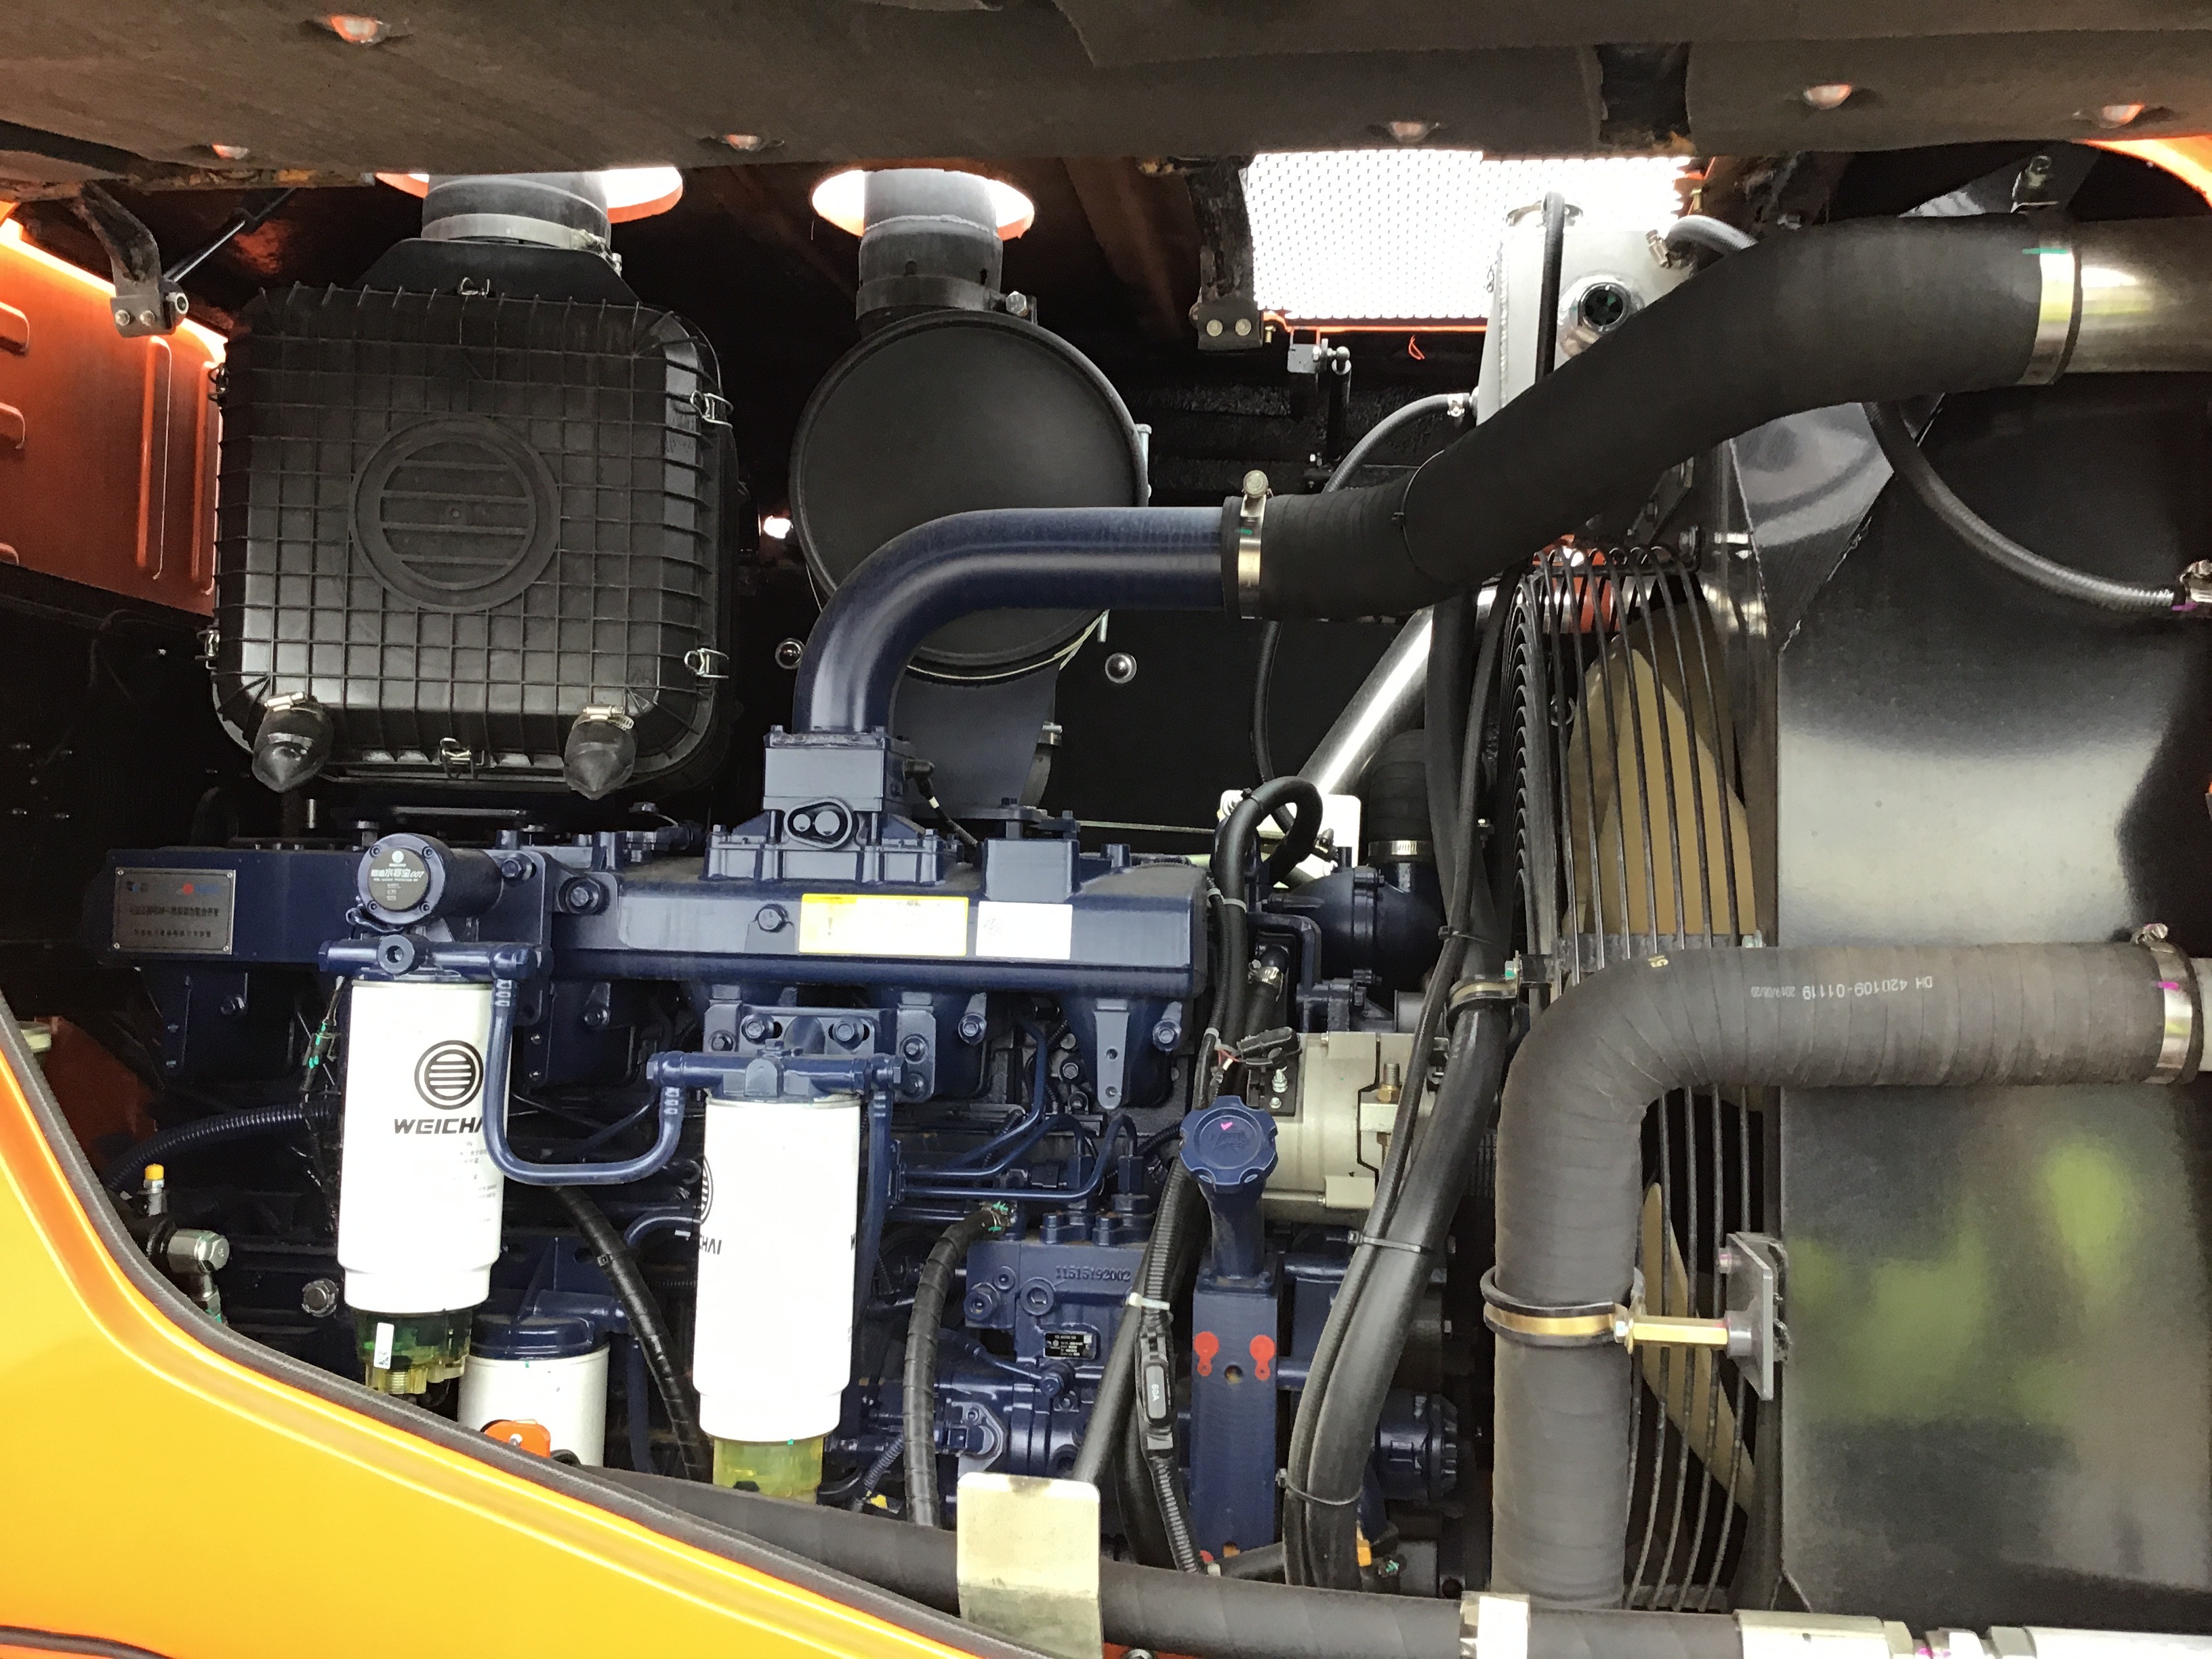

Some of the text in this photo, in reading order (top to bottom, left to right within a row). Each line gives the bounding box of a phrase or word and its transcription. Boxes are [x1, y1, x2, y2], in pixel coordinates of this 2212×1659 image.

[1802, 978, 1908, 1000] 420109-01119
[1915, 975, 1933, 989] DH
[1151, 1384, 1160, 1401] 60A
